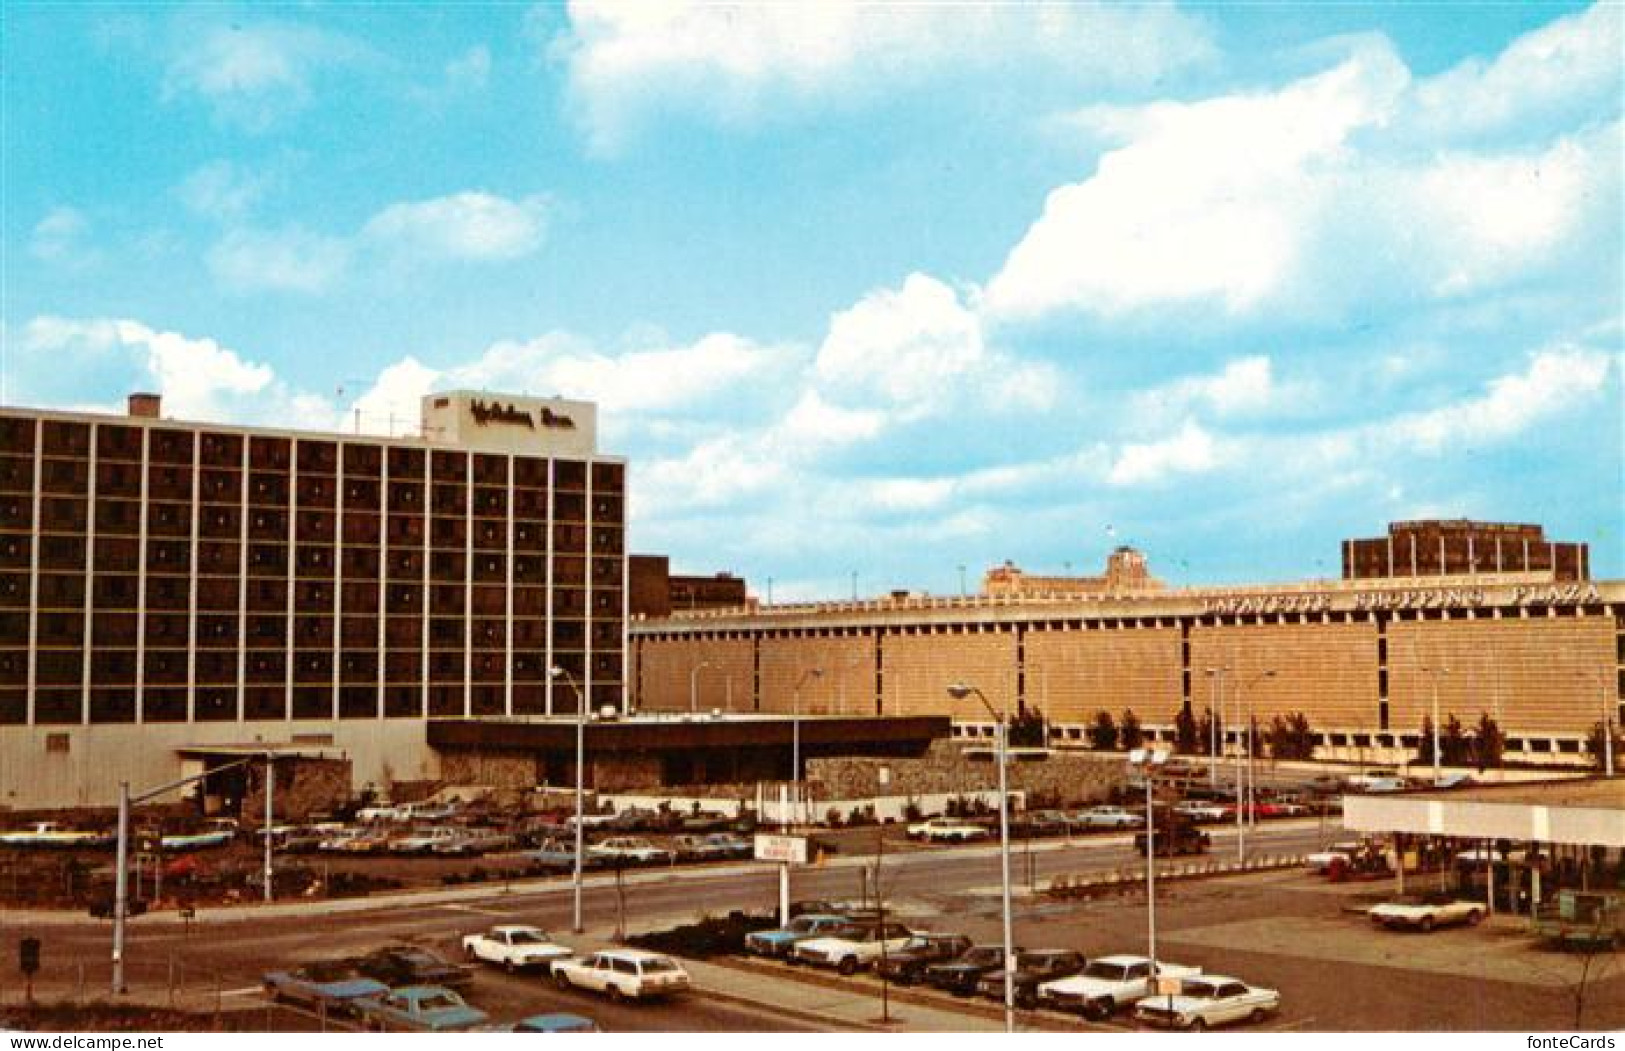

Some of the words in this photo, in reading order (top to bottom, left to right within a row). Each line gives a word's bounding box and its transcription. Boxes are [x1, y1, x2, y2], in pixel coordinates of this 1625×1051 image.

[1204, 595, 1331, 614] LAFAYETTE
[1354, 590, 1484, 609] SHOPPING
[1510, 584, 1600, 604] PLAZA
